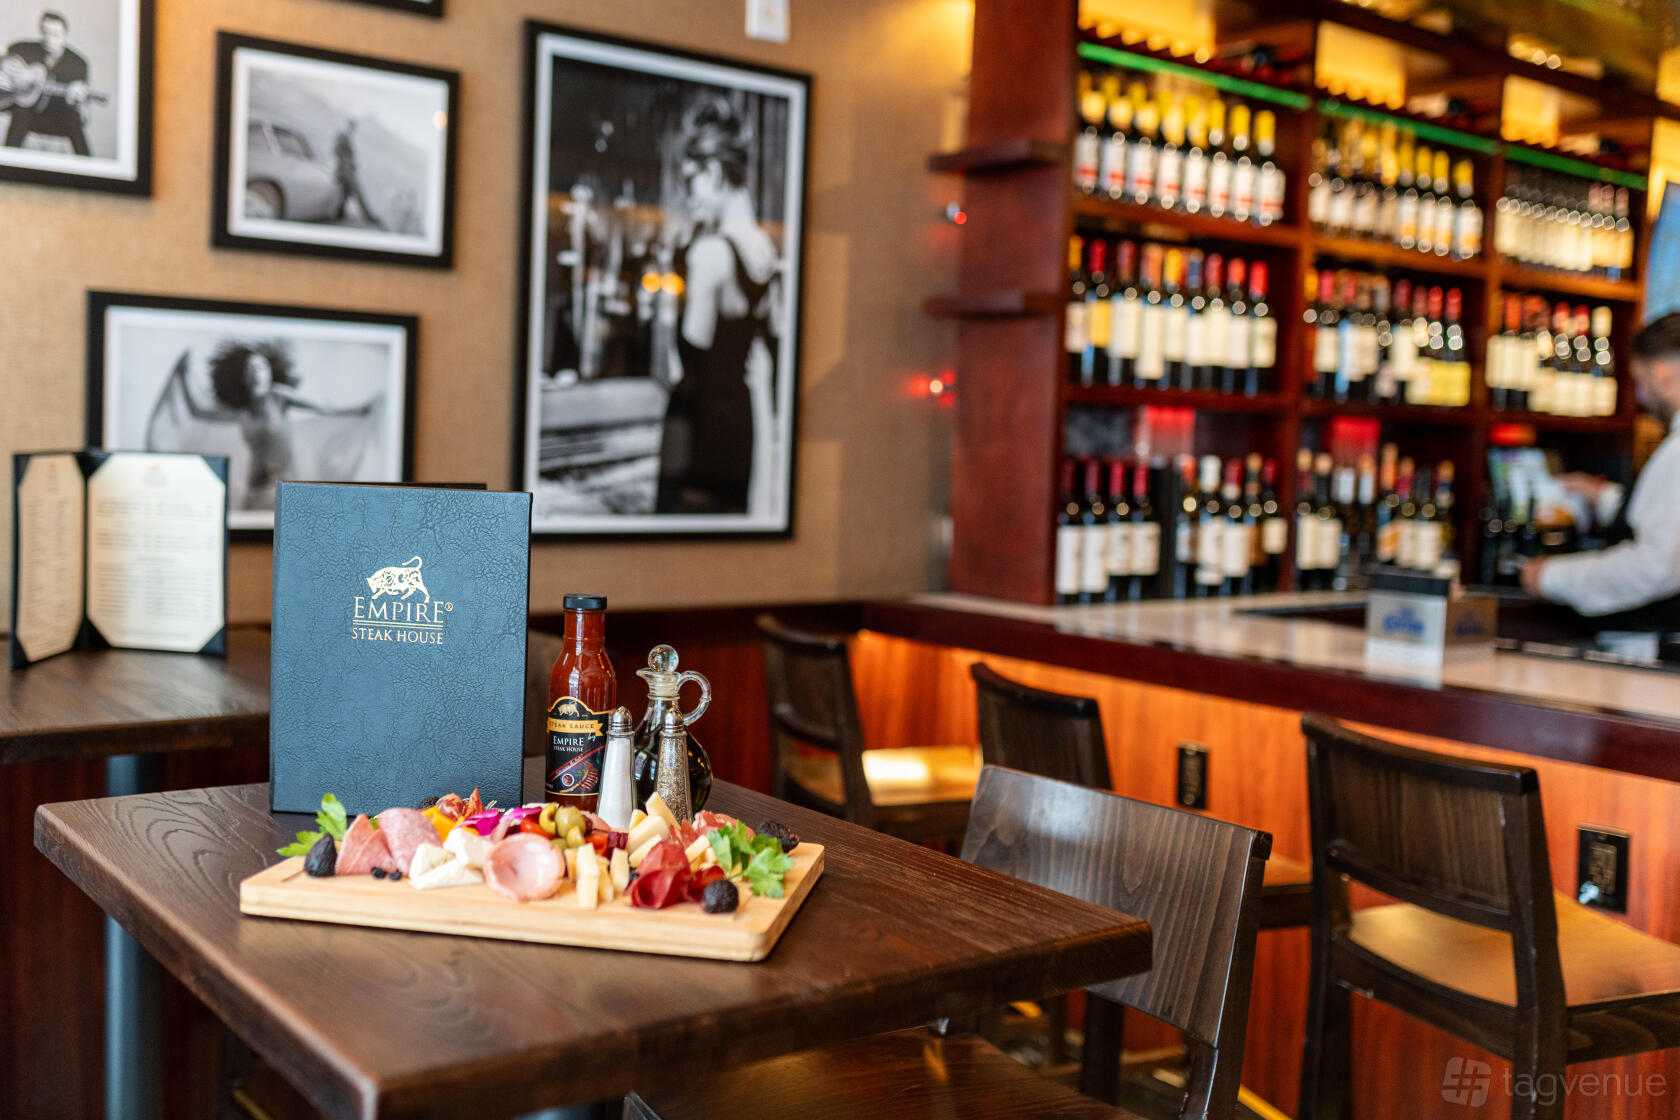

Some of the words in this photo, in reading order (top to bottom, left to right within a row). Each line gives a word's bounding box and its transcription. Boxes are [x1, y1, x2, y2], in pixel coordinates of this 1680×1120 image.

[351, 627, 393, 641] STEAK
[396, 630, 443, 645] HOUSE
[553, 735, 584, 746] EMPIRE
